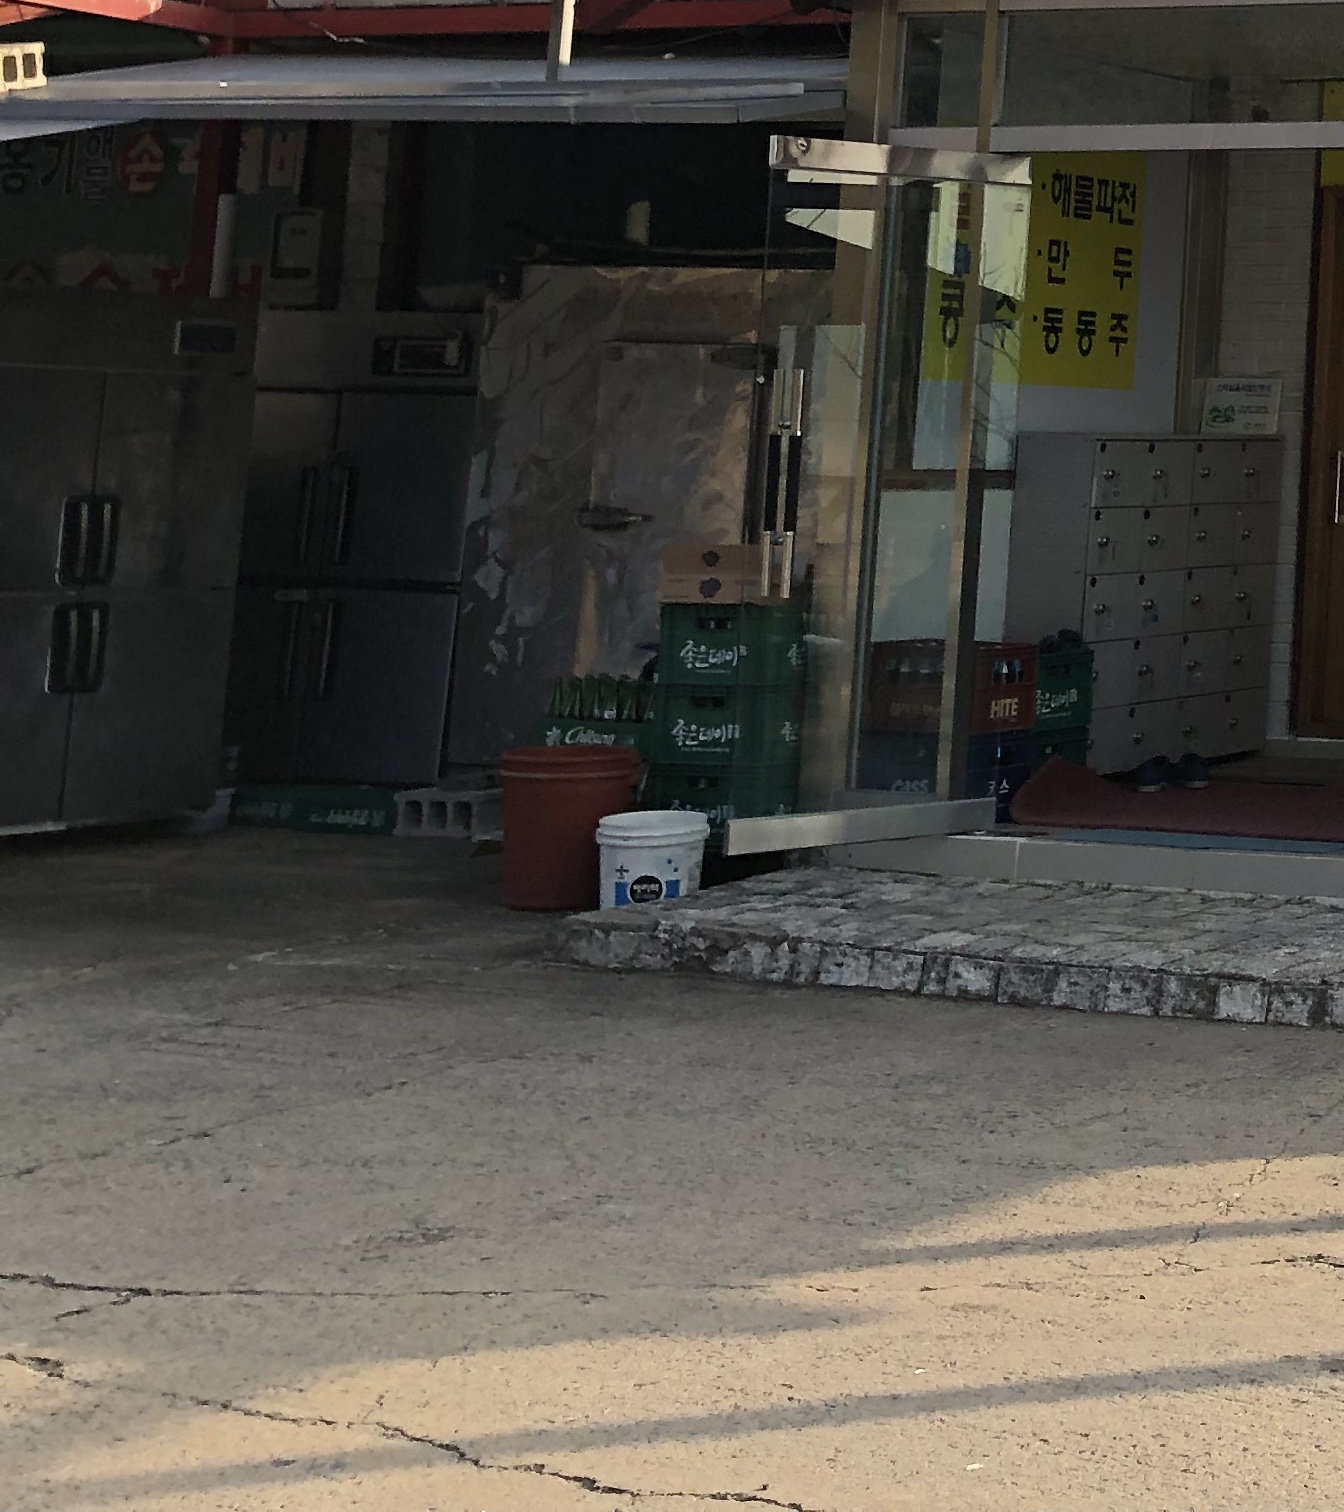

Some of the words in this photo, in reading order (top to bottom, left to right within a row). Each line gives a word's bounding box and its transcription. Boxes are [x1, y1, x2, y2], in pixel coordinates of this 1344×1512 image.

[1051, 169, 1136, 226] 해물파전
[1042, 307, 1128, 357] 동동주
[989, 698, 1019, 719] HITE
